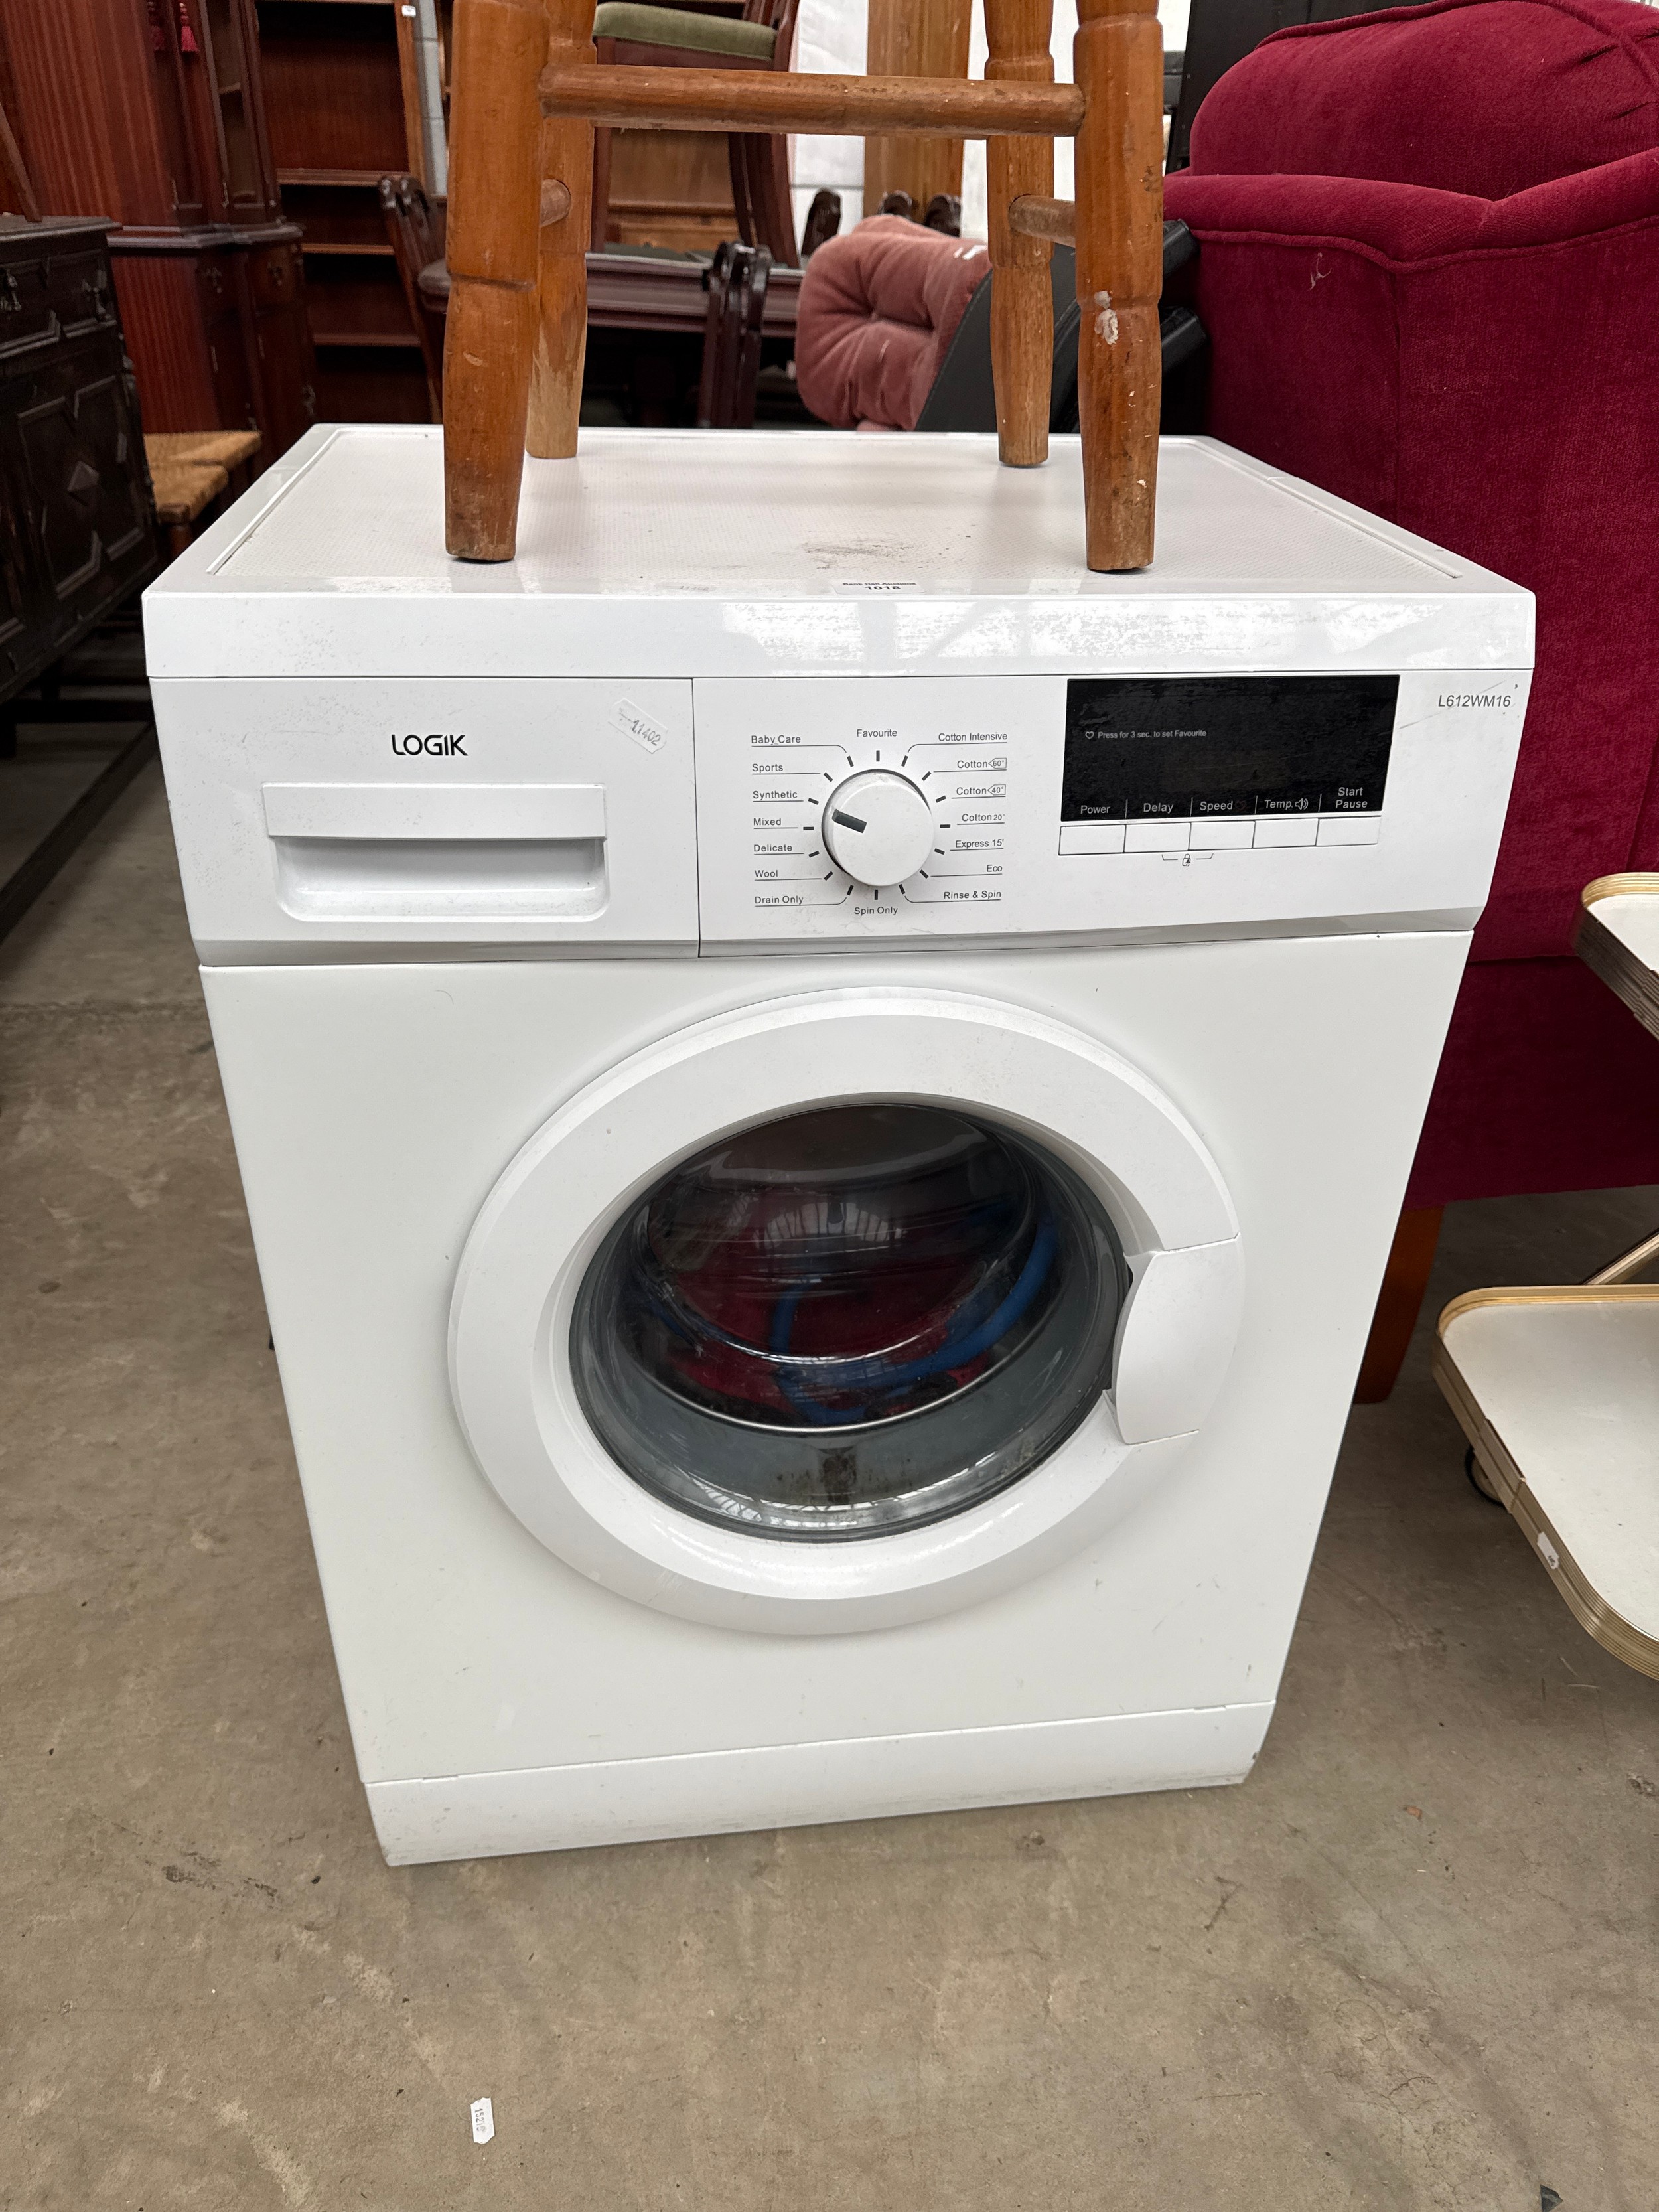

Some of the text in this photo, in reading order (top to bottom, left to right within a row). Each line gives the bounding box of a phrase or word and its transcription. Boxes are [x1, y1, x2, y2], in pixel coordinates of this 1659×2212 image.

[1438, 694, 1511, 707] L612WM16
[857, 728, 897, 737] Favourite
[938, 732, 1007, 741] Cotton Intensive
[392, 734, 469, 756] LOGIK
[751, 735, 801, 745] Baby Care
[752, 763, 783, 773] Sports
[957, 760, 987, 769] Cotton
[753, 790, 798, 800] Synthetic
[956, 786, 987, 795] Cotton
[1338, 787, 1363, 796] Start
[1143, 802, 1173, 814] Delay
[1199, 801, 1234, 812] Speed
[1264, 799, 1293, 810] Temp.
[1335, 799, 1368, 809] Pause
[1080, 805, 1110, 814] Power
[754, 844, 792, 852] Delicate
[955, 840, 989, 849] Express
[981, 890, 1001, 899] Spin
[782, 895, 804, 905] Only
[854, 906, 899, 916] Spin Only
